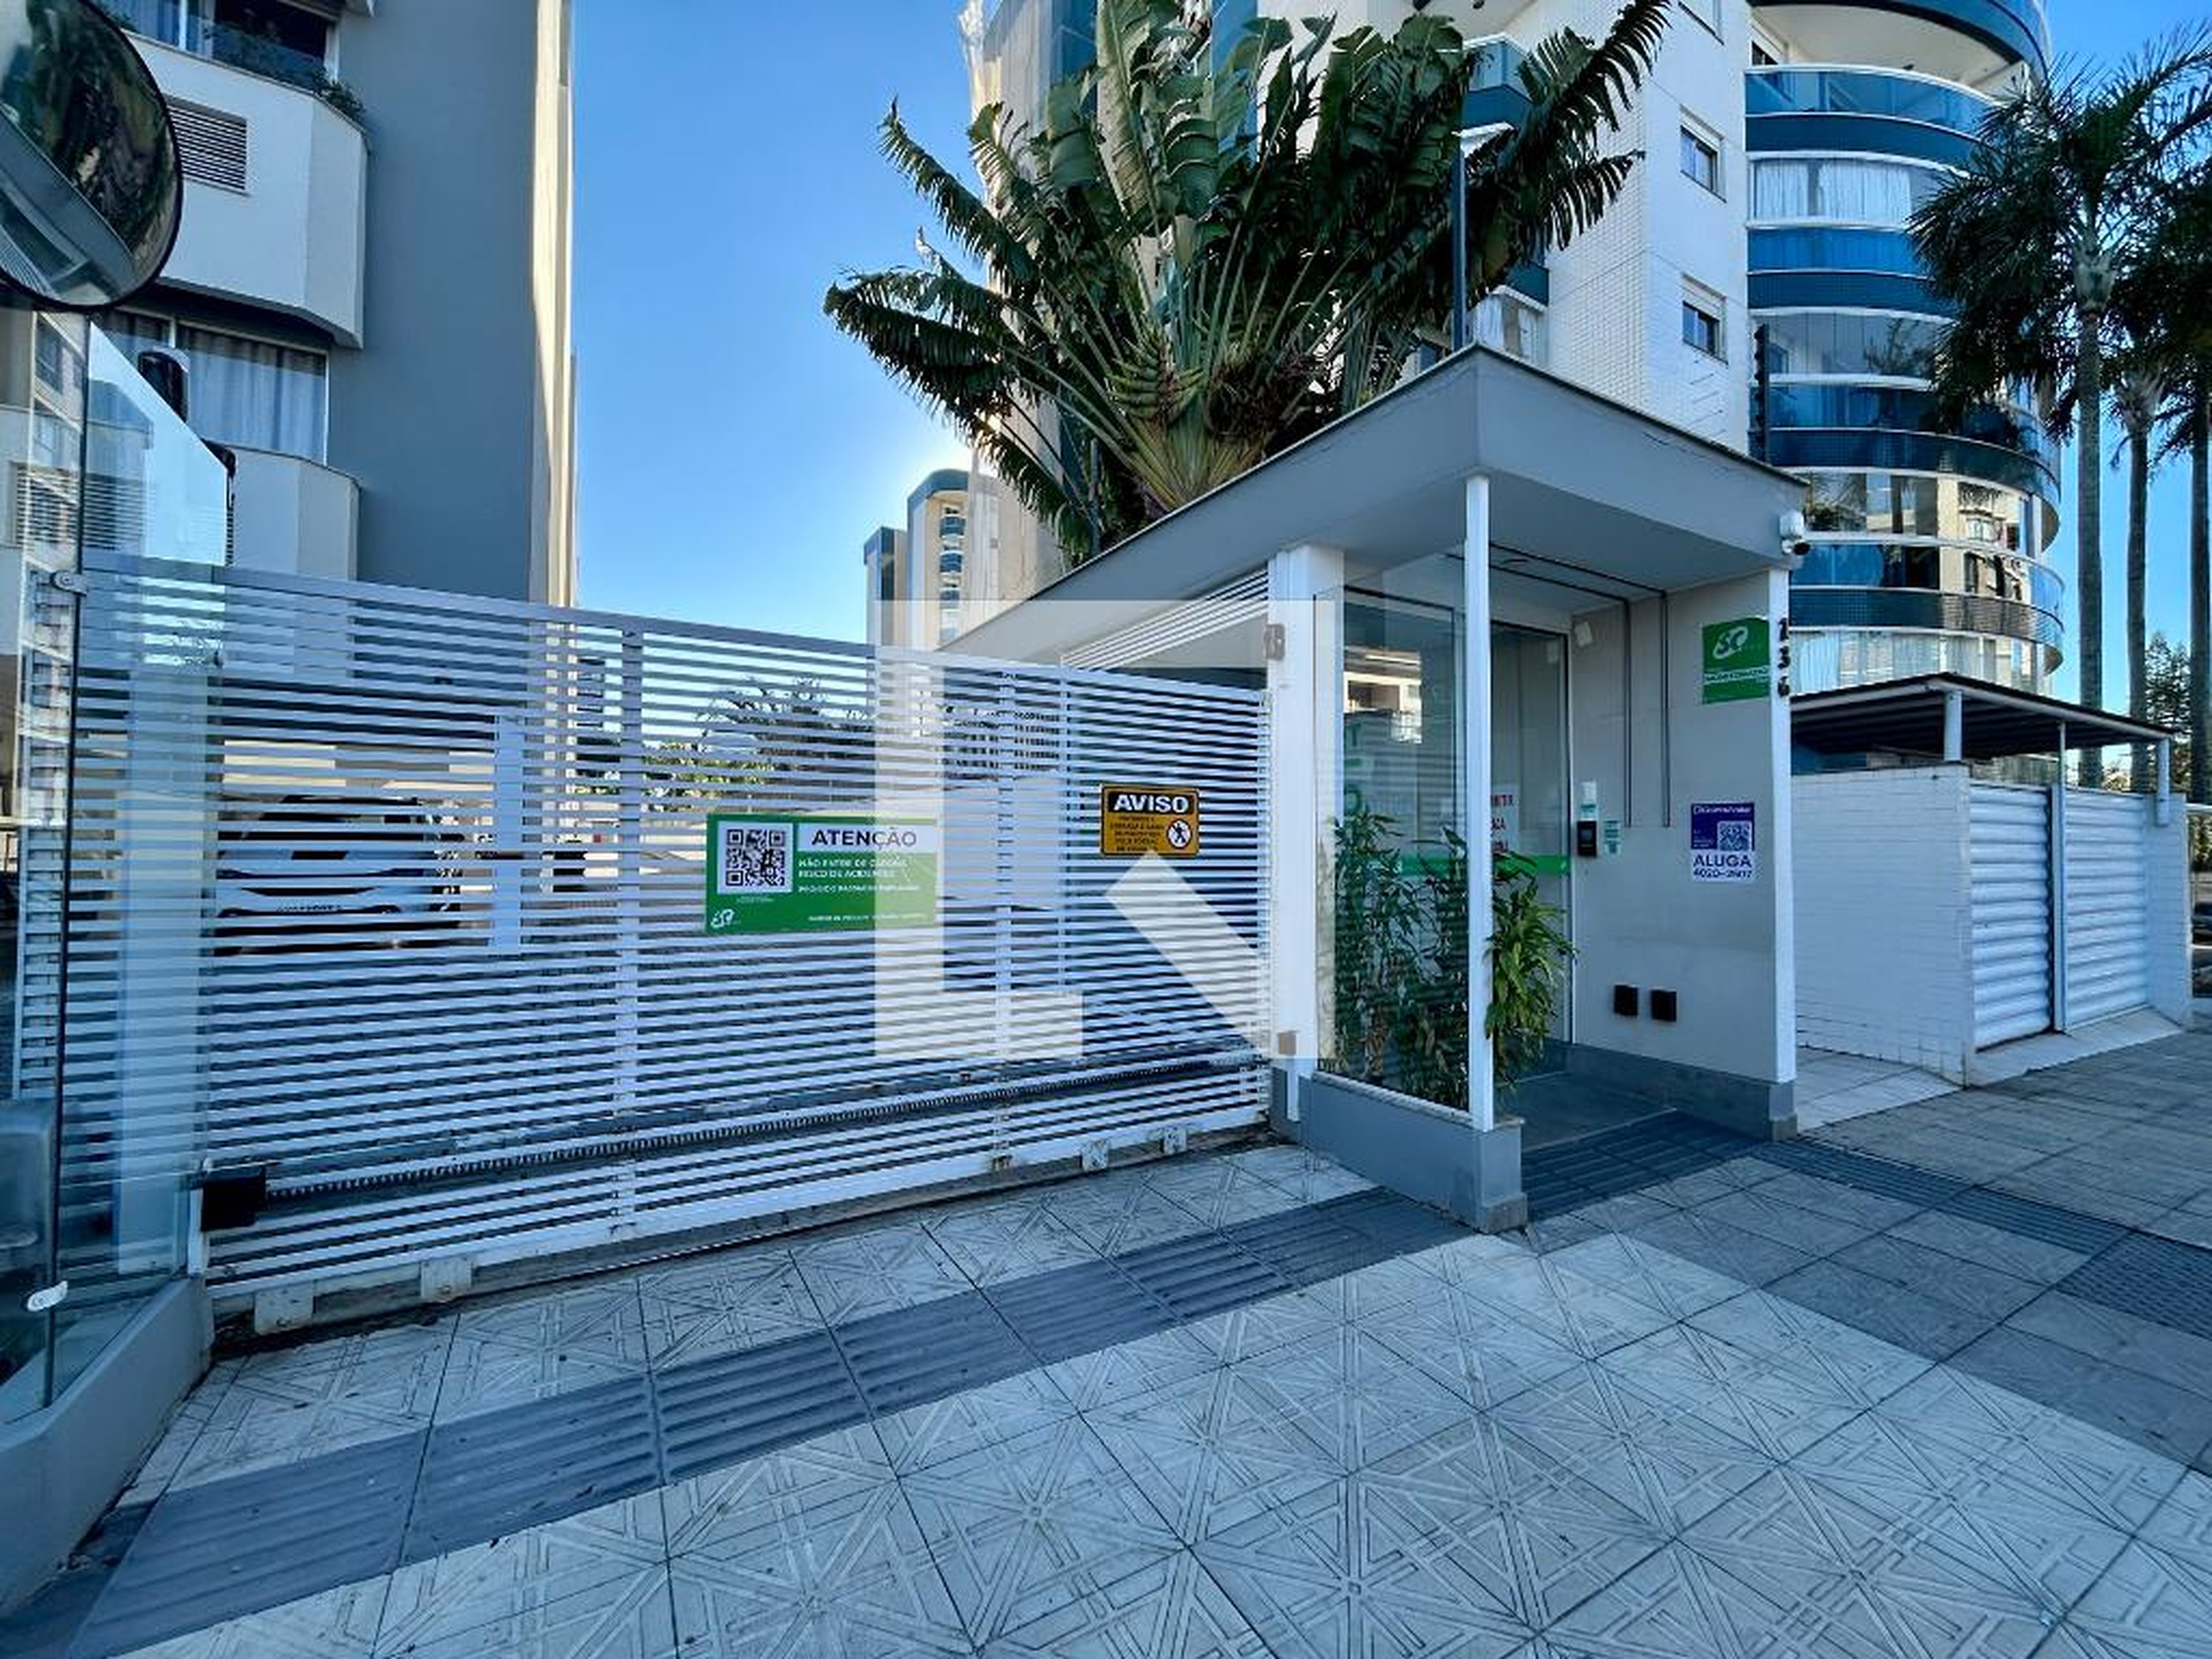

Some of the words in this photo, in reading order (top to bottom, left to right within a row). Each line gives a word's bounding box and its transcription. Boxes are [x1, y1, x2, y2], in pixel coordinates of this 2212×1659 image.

[1113, 794, 1189, 813] AVISO
[812, 826, 917, 850] ATENÇÃO
[1694, 855, 1752, 868] ALUGA
